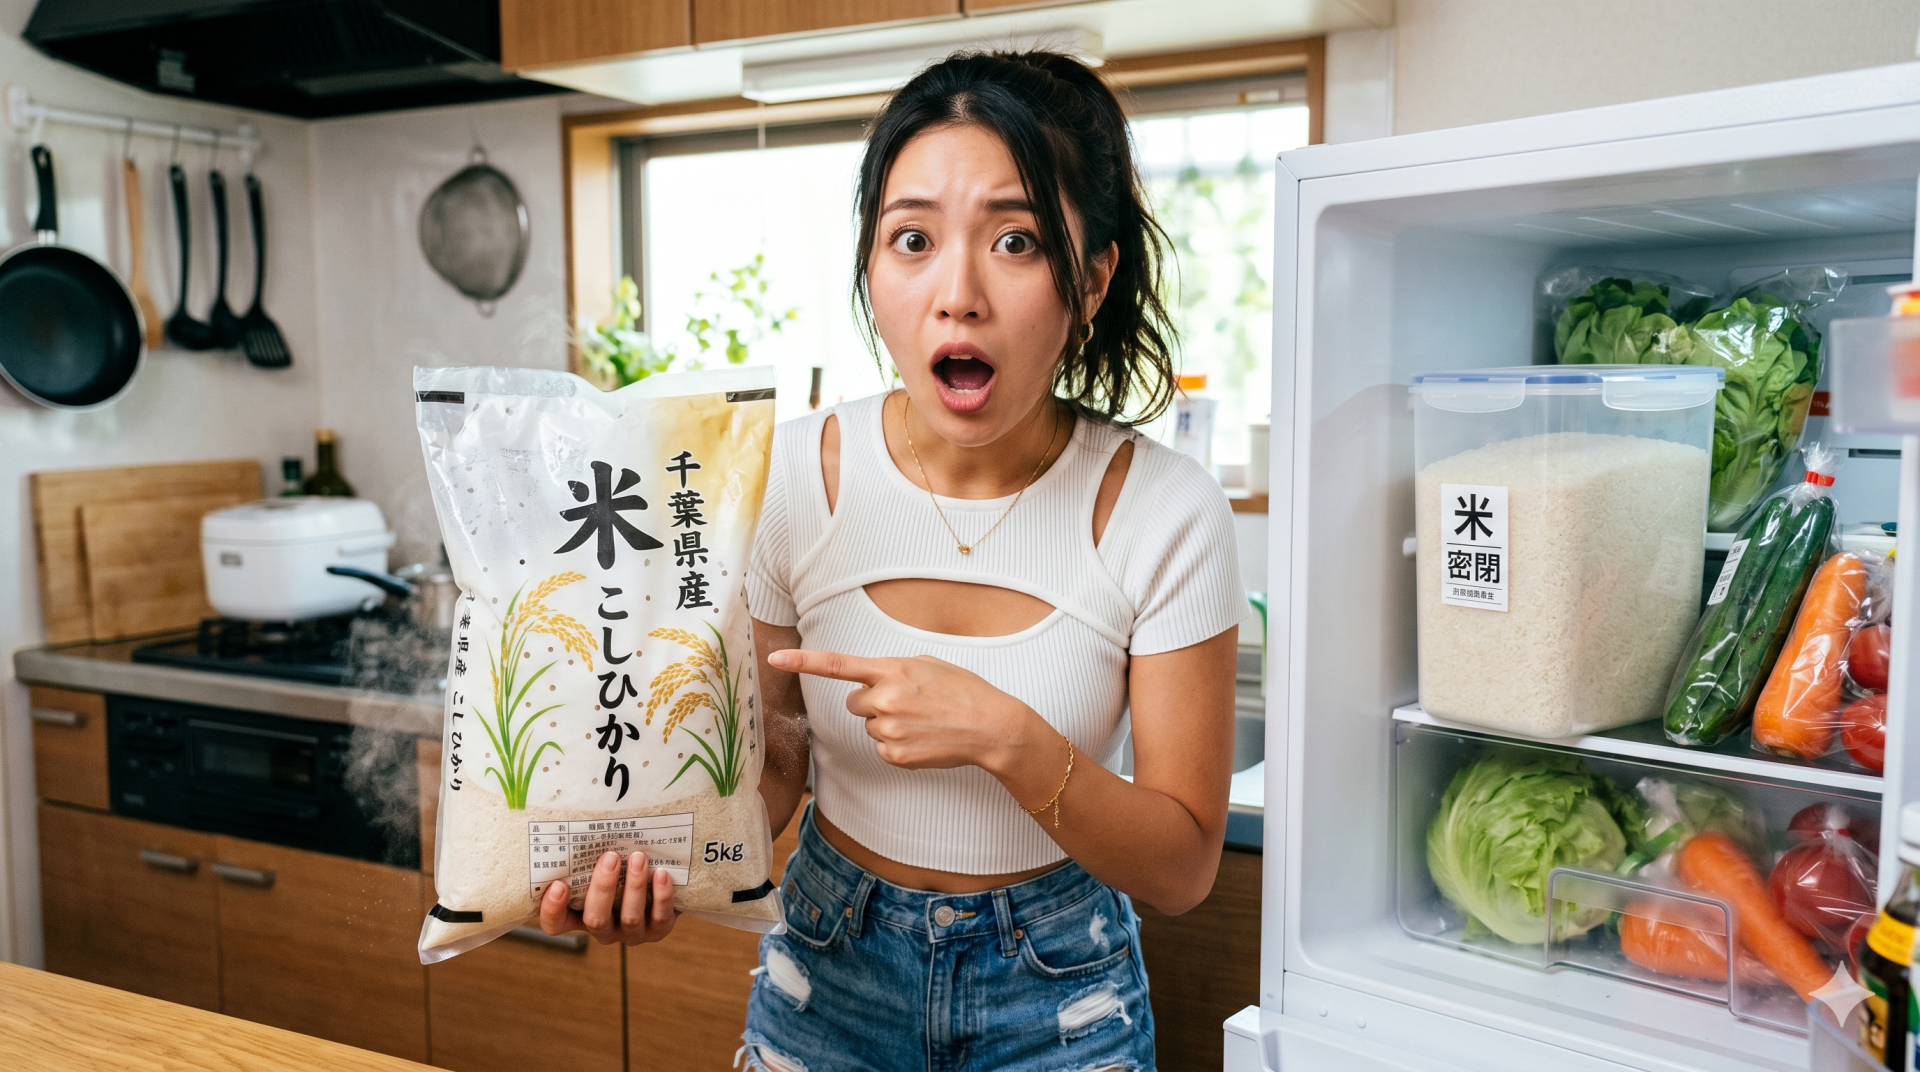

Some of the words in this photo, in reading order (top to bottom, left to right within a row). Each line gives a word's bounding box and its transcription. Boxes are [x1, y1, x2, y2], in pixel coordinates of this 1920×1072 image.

[553, 460, 664, 570] 米
[665, 450, 713, 611] 千葉県産
[1453, 493, 1493, 541] 米
[1447, 549, 1501, 584] 密閉
[449, 690, 465, 791] こしひかり
[595, 585, 641, 803] こしひかり
[703, 841, 744, 864] 5kg
